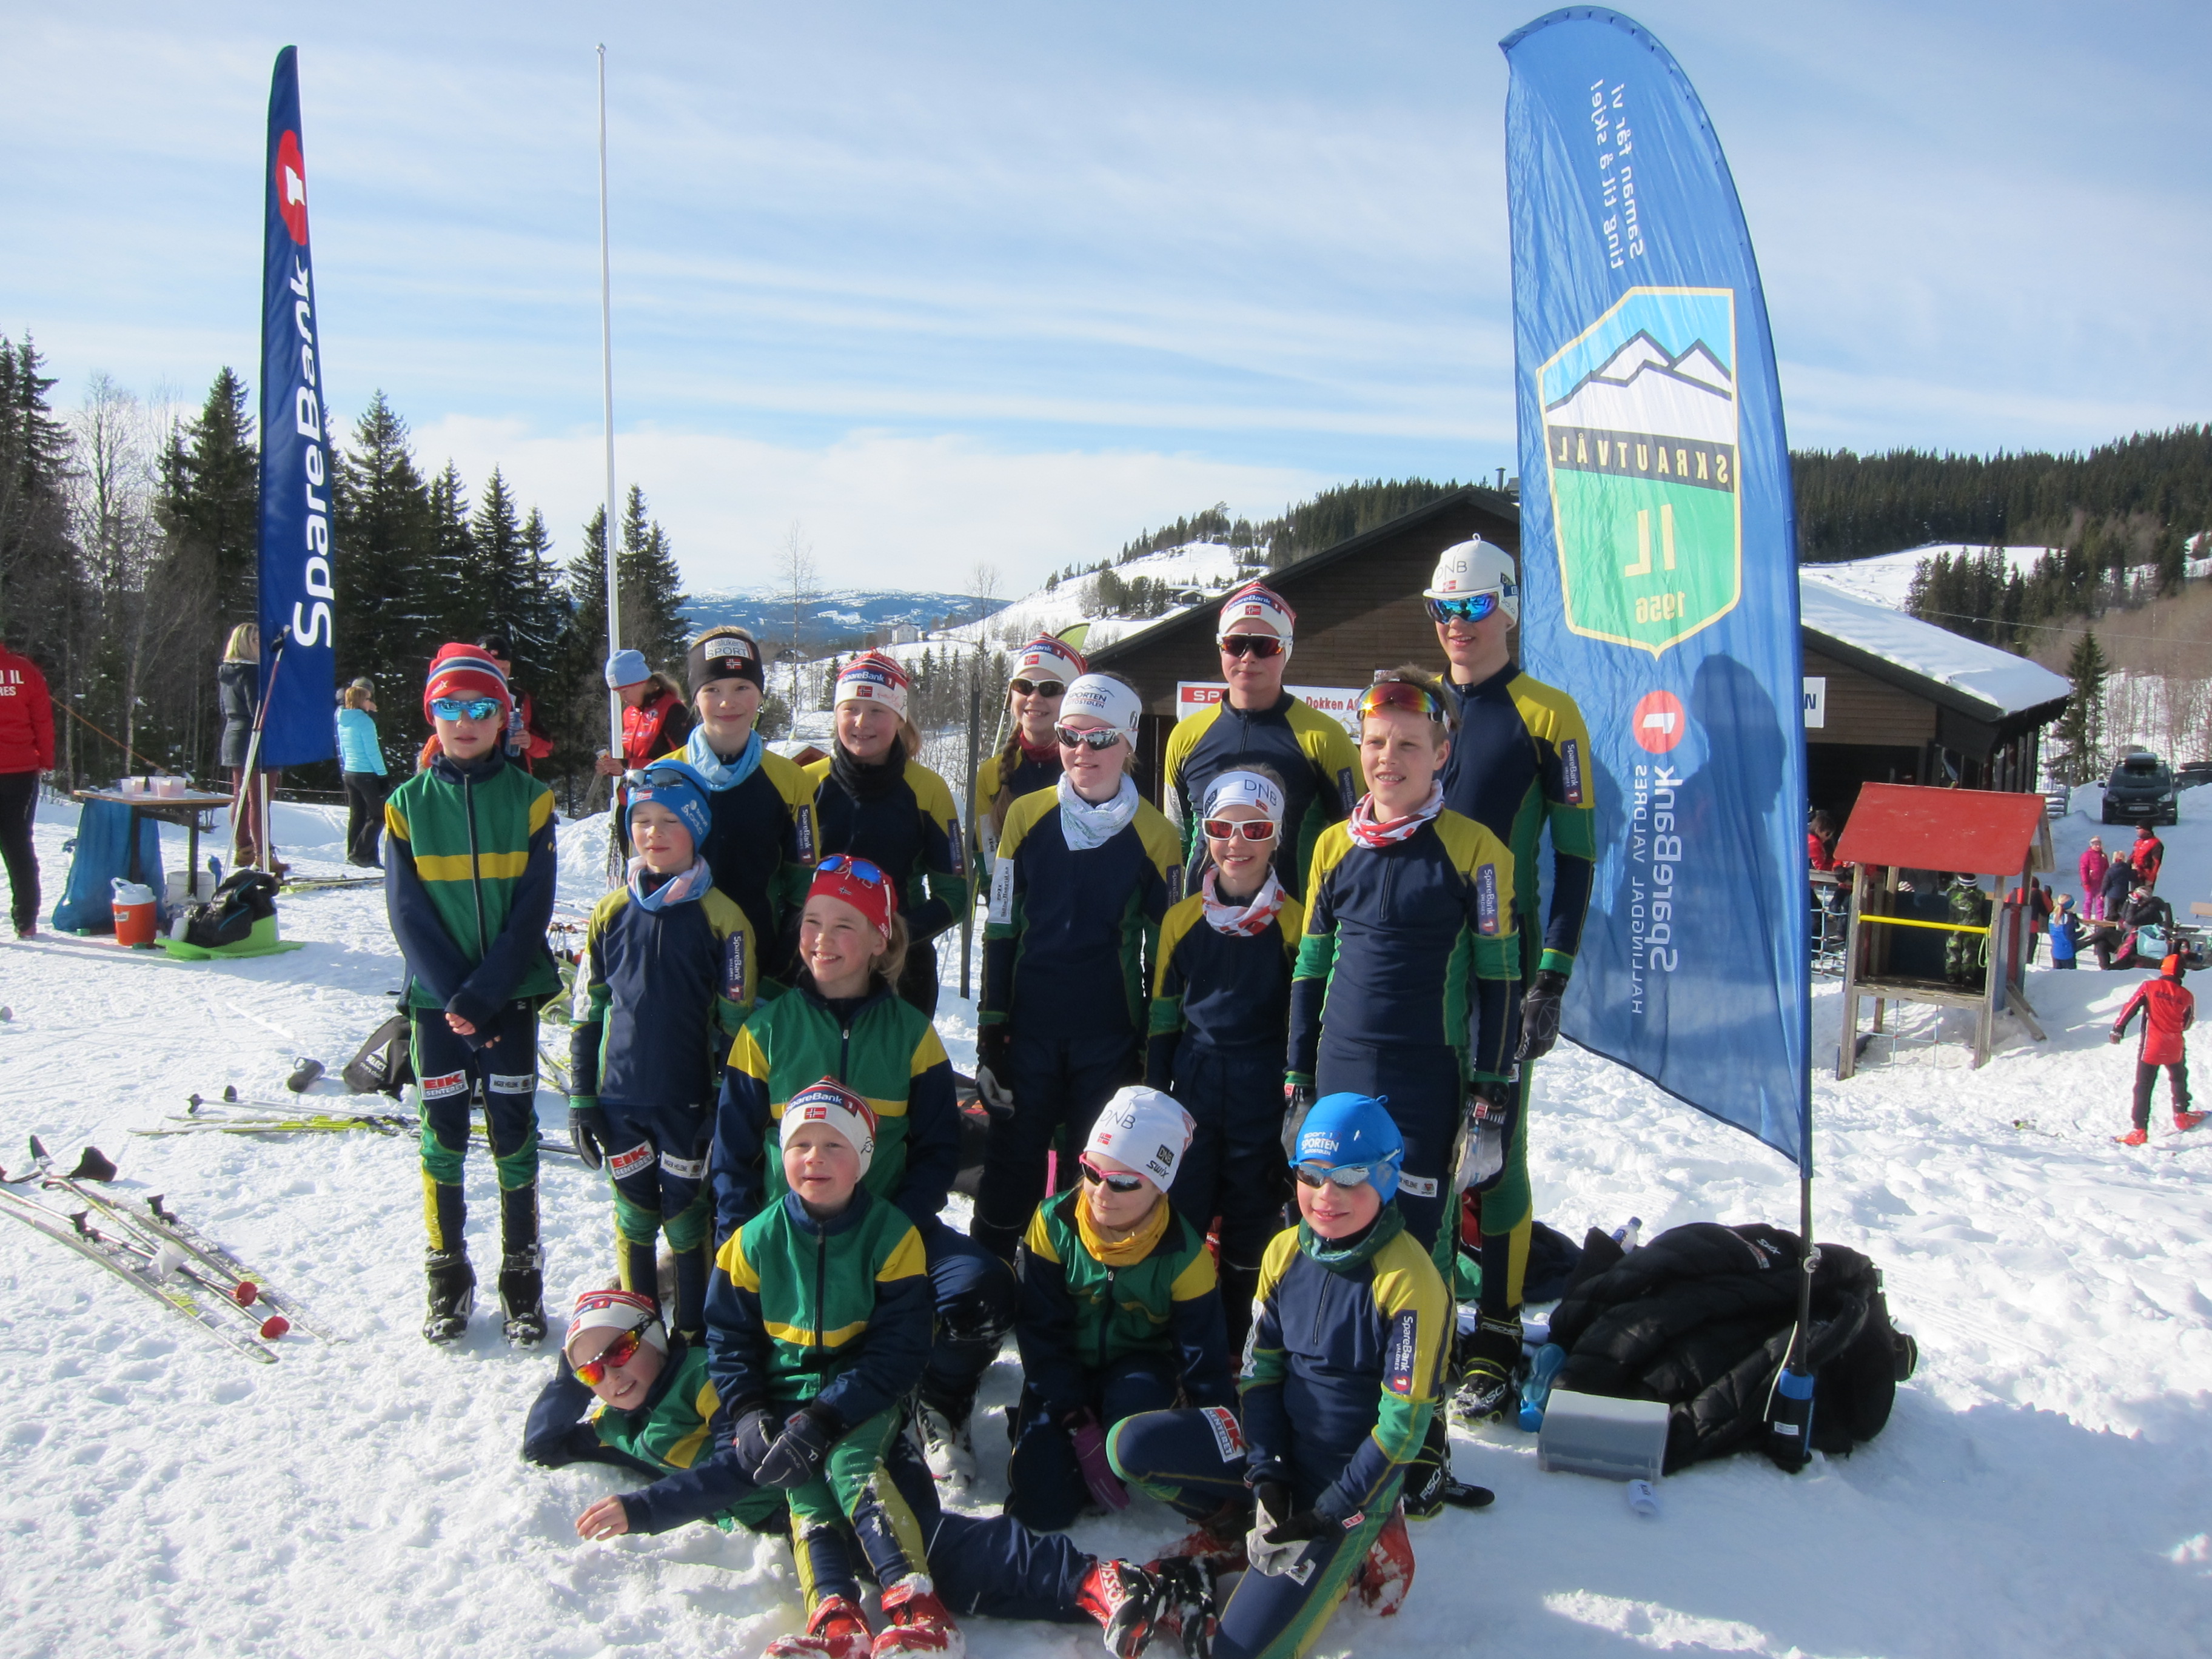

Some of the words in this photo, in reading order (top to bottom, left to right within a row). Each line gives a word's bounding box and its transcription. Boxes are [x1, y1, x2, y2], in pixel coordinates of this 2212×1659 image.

[290, 253, 334, 648] SpareBank
[1436, 555, 1468, 580] DNB
[707, 647, 746, 659] SPORT
[10, 669, 24, 684] IL
[1068, 692, 1107, 702] SPORTEN
[1306, 696, 1344, 711] Dokken
[1567, 743, 1578, 786] SpareBank
[1244, 779, 1277, 806] DNB
[801, 809, 811, 849] SpareBank
[1484, 869, 1495, 915] SpareBank
[733, 936, 742, 980] SpareBank
[366, 1054, 387, 1072] SELECT
[424, 1073, 463, 1089] EIK
[787, 1092, 843, 1111] SpareBank
[1101, 1102, 1136, 1130] DNB
[611, 1145, 649, 1168] EIK
[1158, 1147, 1173, 1164] DNB
[1301, 1138, 1339, 1152] SPORTEN
[1399, 1315, 1413, 1373] SpareBank
[1214, 1408, 1245, 1452] EIK
